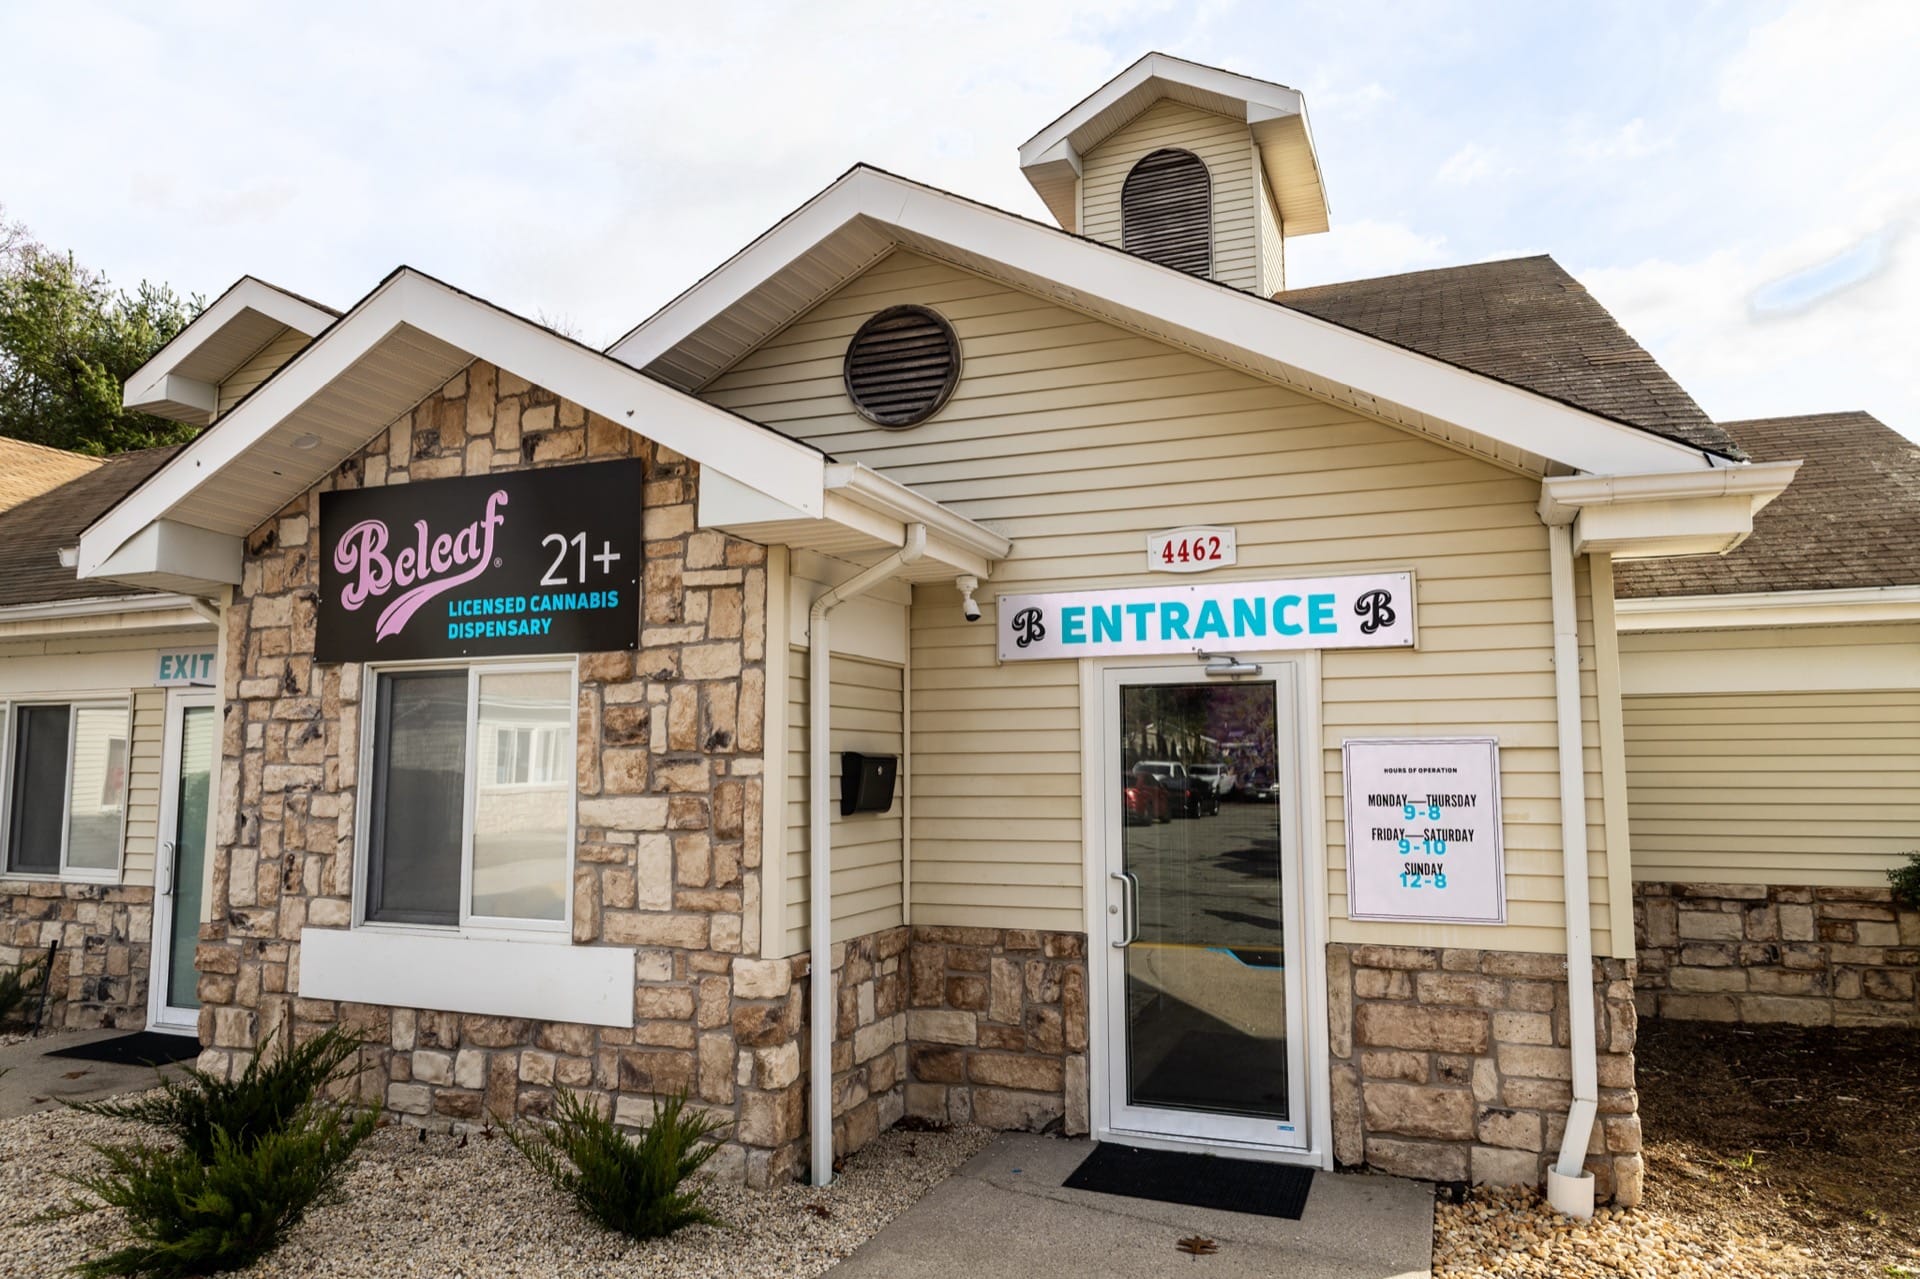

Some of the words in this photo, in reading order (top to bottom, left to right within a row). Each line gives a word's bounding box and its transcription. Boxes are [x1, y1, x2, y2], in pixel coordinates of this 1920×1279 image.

[540, 531, 621, 586] 21+
[1161, 536, 1222, 564] 4462
[448, 597, 526, 617] LICENSED
[530, 590, 619, 612] CANNABIS
[448, 618, 552, 640] DISPENSARY
[1060, 593, 1338, 645] ENTRANCE
[159, 653, 214, 680] EXIT
[1404, 862, 1443, 876] SUNDAY
